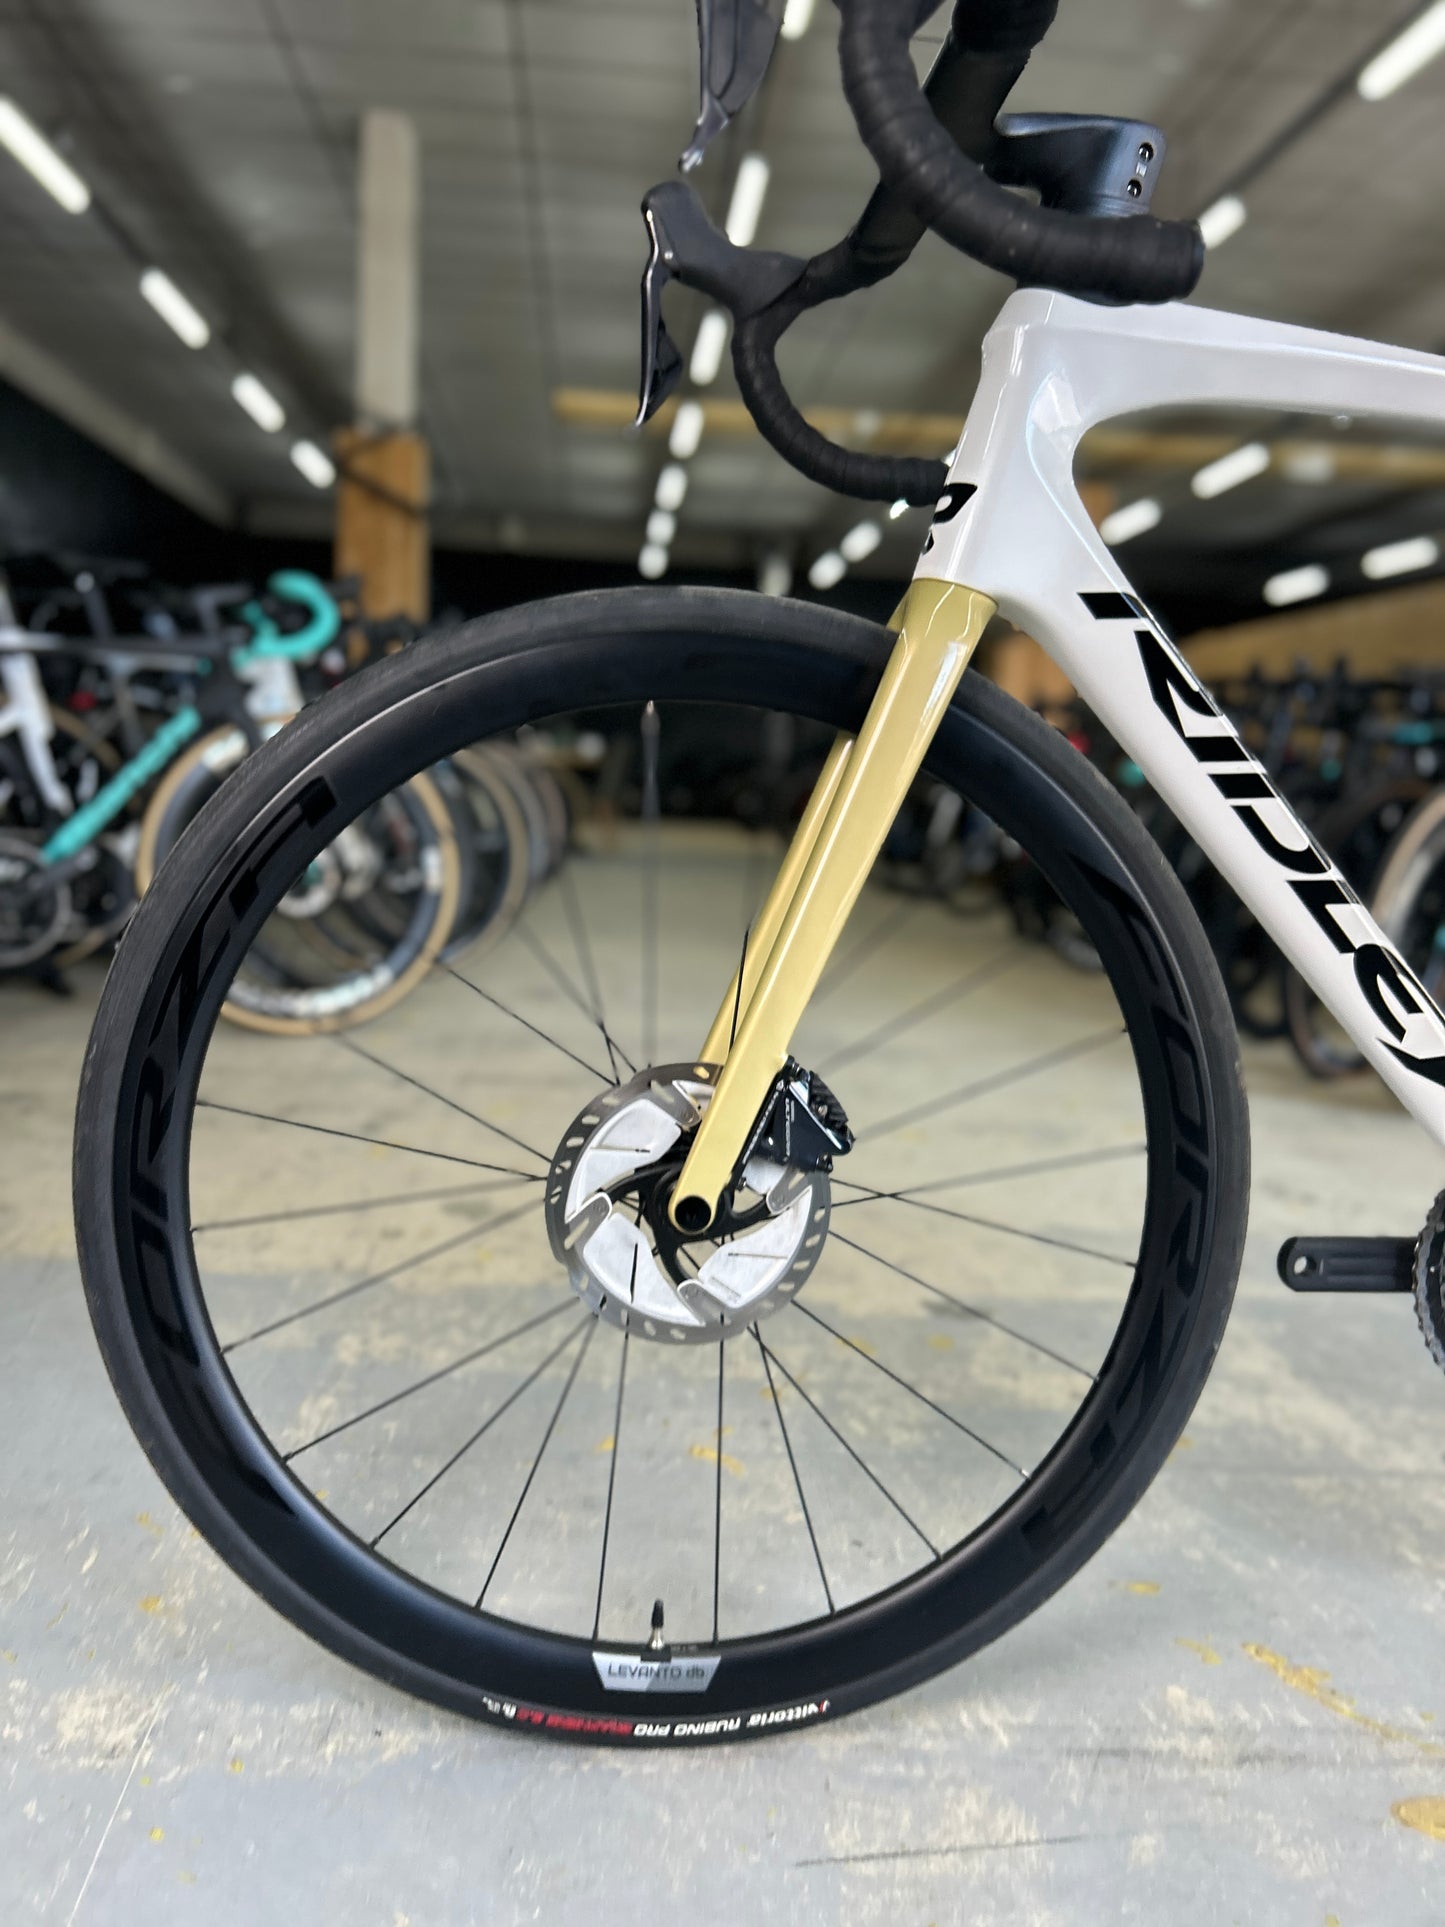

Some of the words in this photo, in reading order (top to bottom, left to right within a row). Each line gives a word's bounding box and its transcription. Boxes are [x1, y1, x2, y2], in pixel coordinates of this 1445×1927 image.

[130, 776, 338, 1515] FORZA
[1020, 852, 1211, 1554] FORZA
[608, 1663, 681, 1678] LEVANTO
[633, 1722, 671, 1737] PRO
